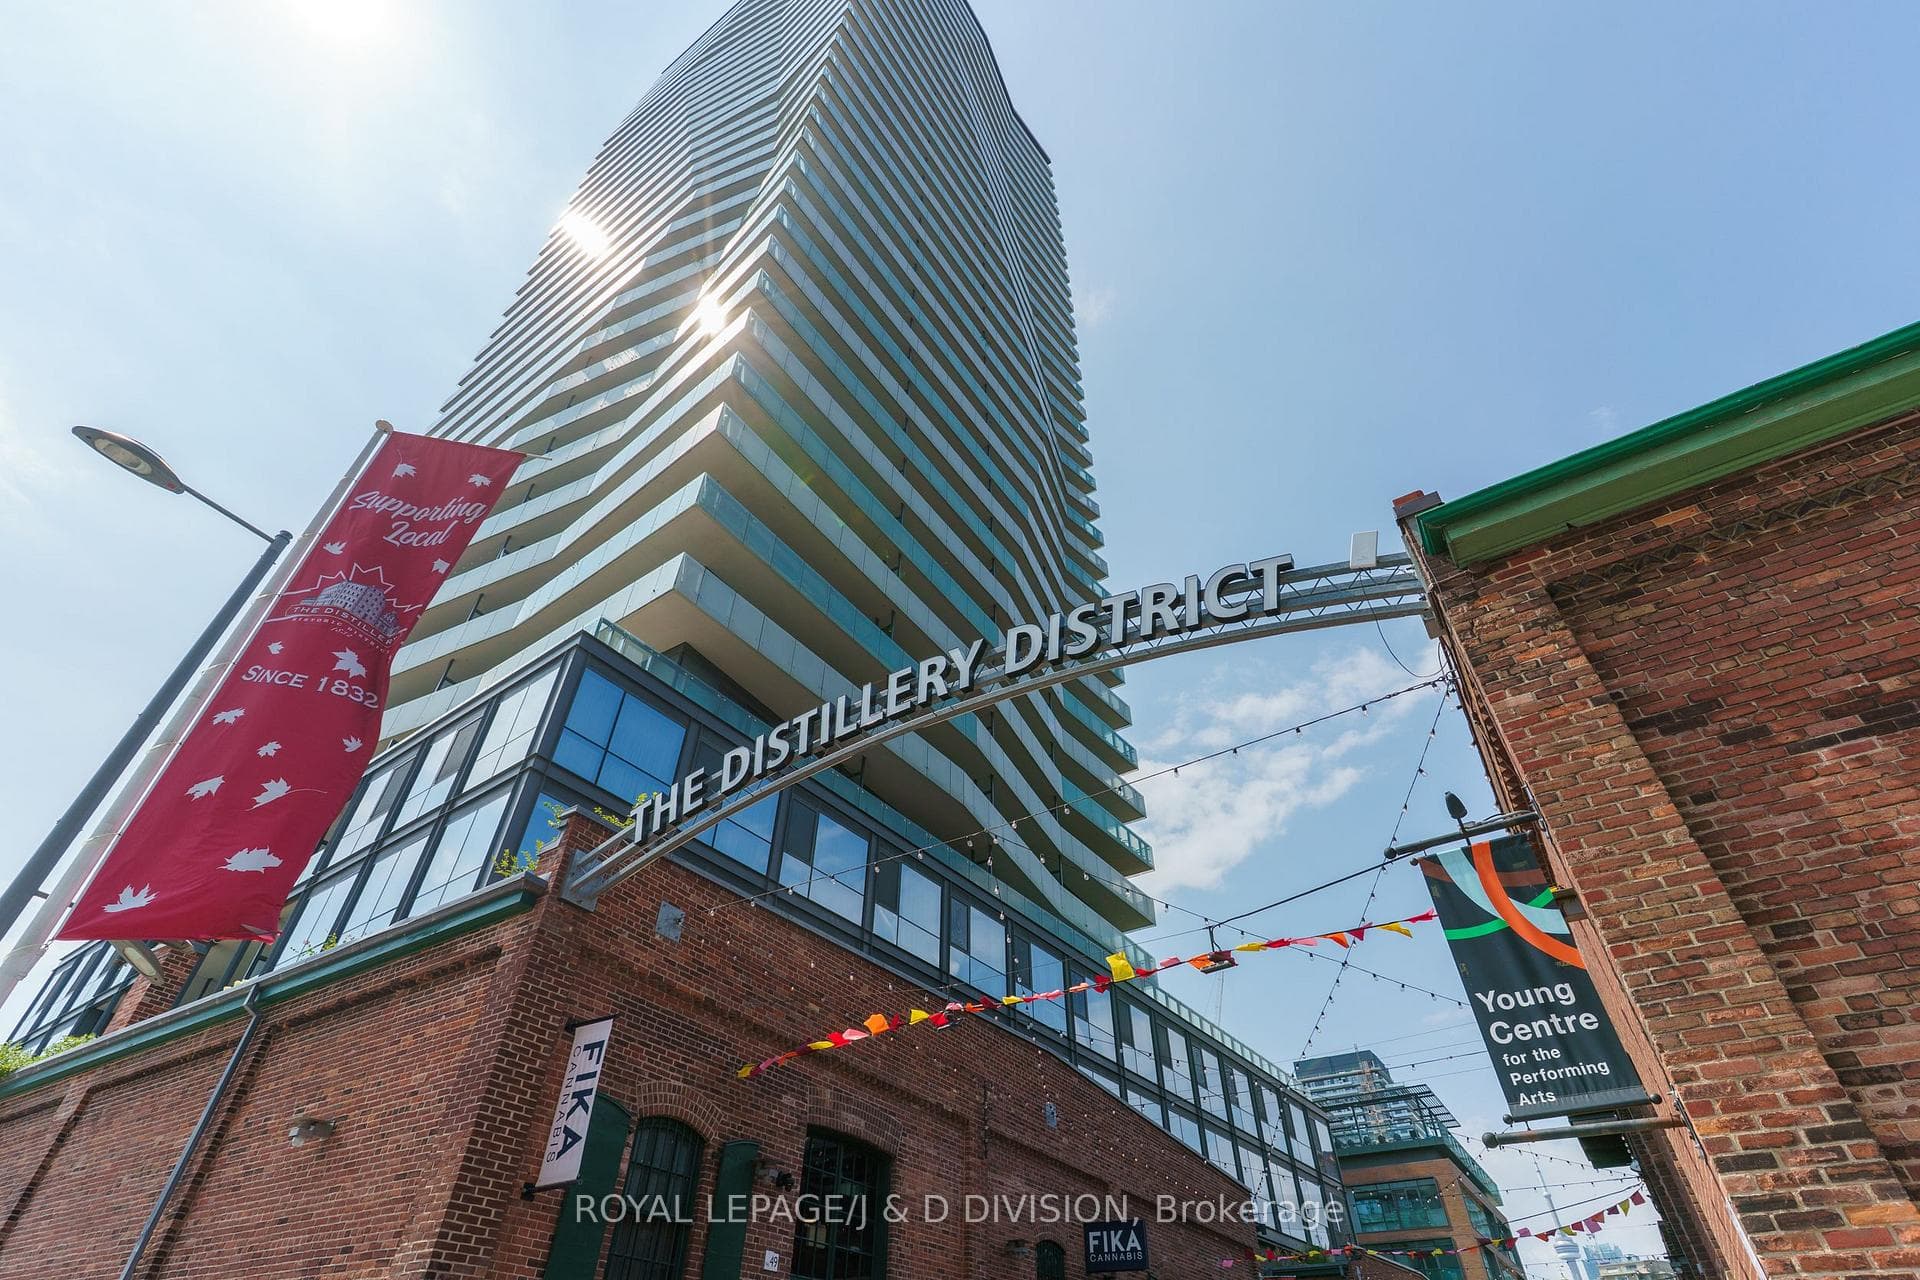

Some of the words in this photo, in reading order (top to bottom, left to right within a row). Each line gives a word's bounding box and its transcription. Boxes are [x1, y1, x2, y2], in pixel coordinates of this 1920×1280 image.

[349, 491, 487, 524] Supporting
[383, 520, 459, 547] Local
[293, 606, 320, 614] THE
[242, 665, 309, 688] SINCE
[317, 676, 379, 709] 1832
[630, 767, 705, 845] THE
[720, 638, 988, 795] DISTILLERY
[1004, 553, 1295, 677] DISTRICT
[1475, 982, 1576, 1013] Young
[1489, 1012, 1599, 1045] Centre
[1502, 1053, 1527, 1067] for
[1532, 1047, 1561, 1062] the
[1510, 1061, 1611, 1086] Performing
[546, 1045, 581, 1163] CANNABIS
[556, 1040, 606, 1161] FIKA
[1520, 1090, 1557, 1107] Arts
[1088, 1229, 1142, 1253] FIKA
[1089, 1252, 1144, 1263] CANNABIS
